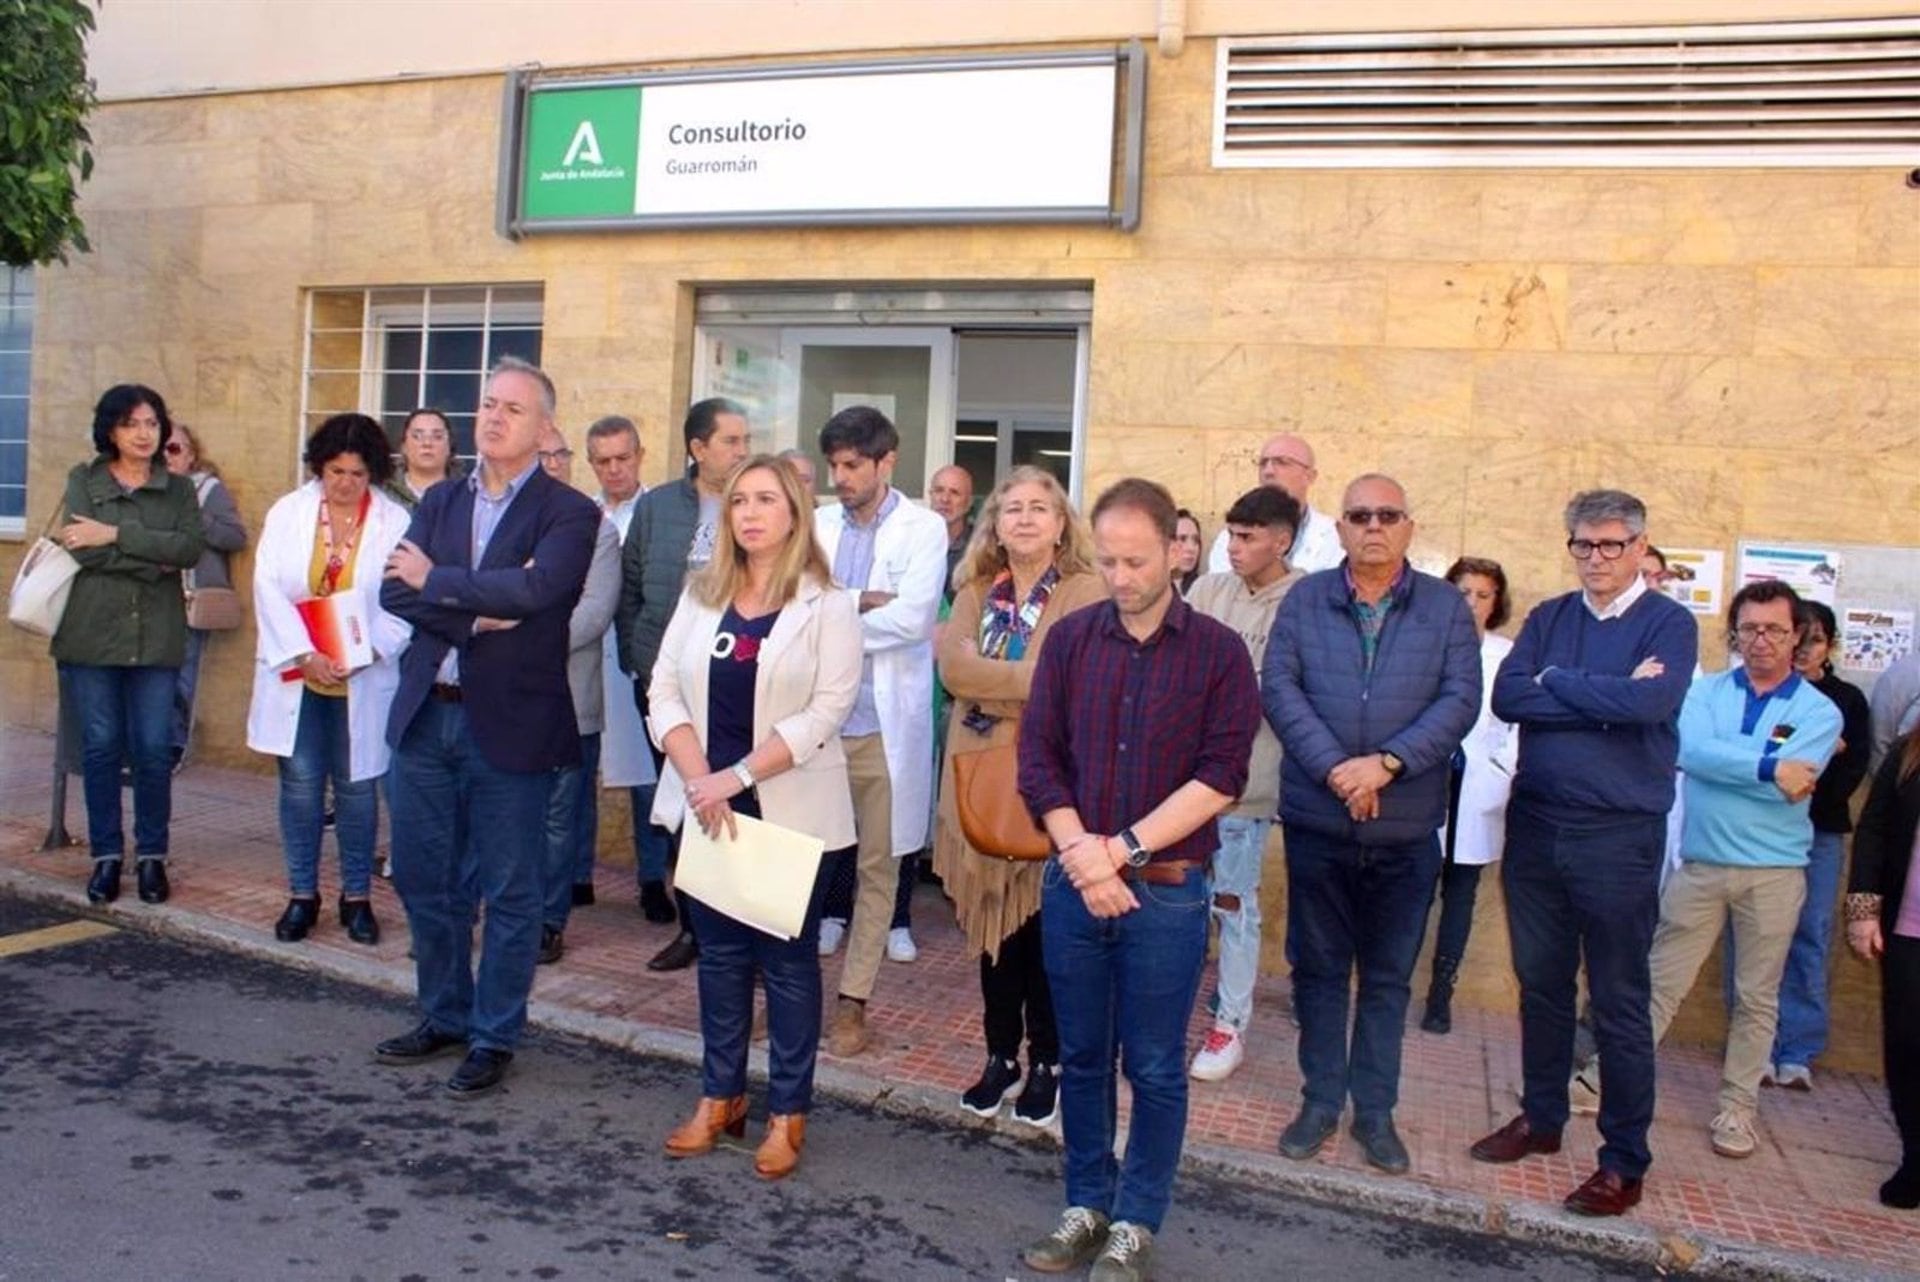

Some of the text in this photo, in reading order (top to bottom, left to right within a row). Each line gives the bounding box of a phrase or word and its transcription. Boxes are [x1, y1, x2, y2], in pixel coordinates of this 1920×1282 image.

[668, 116, 807, 146] Consultorio
[540, 171, 565, 181] Junta
[567, 169, 578, 179] de
[665, 153, 759, 176] Guarromán
